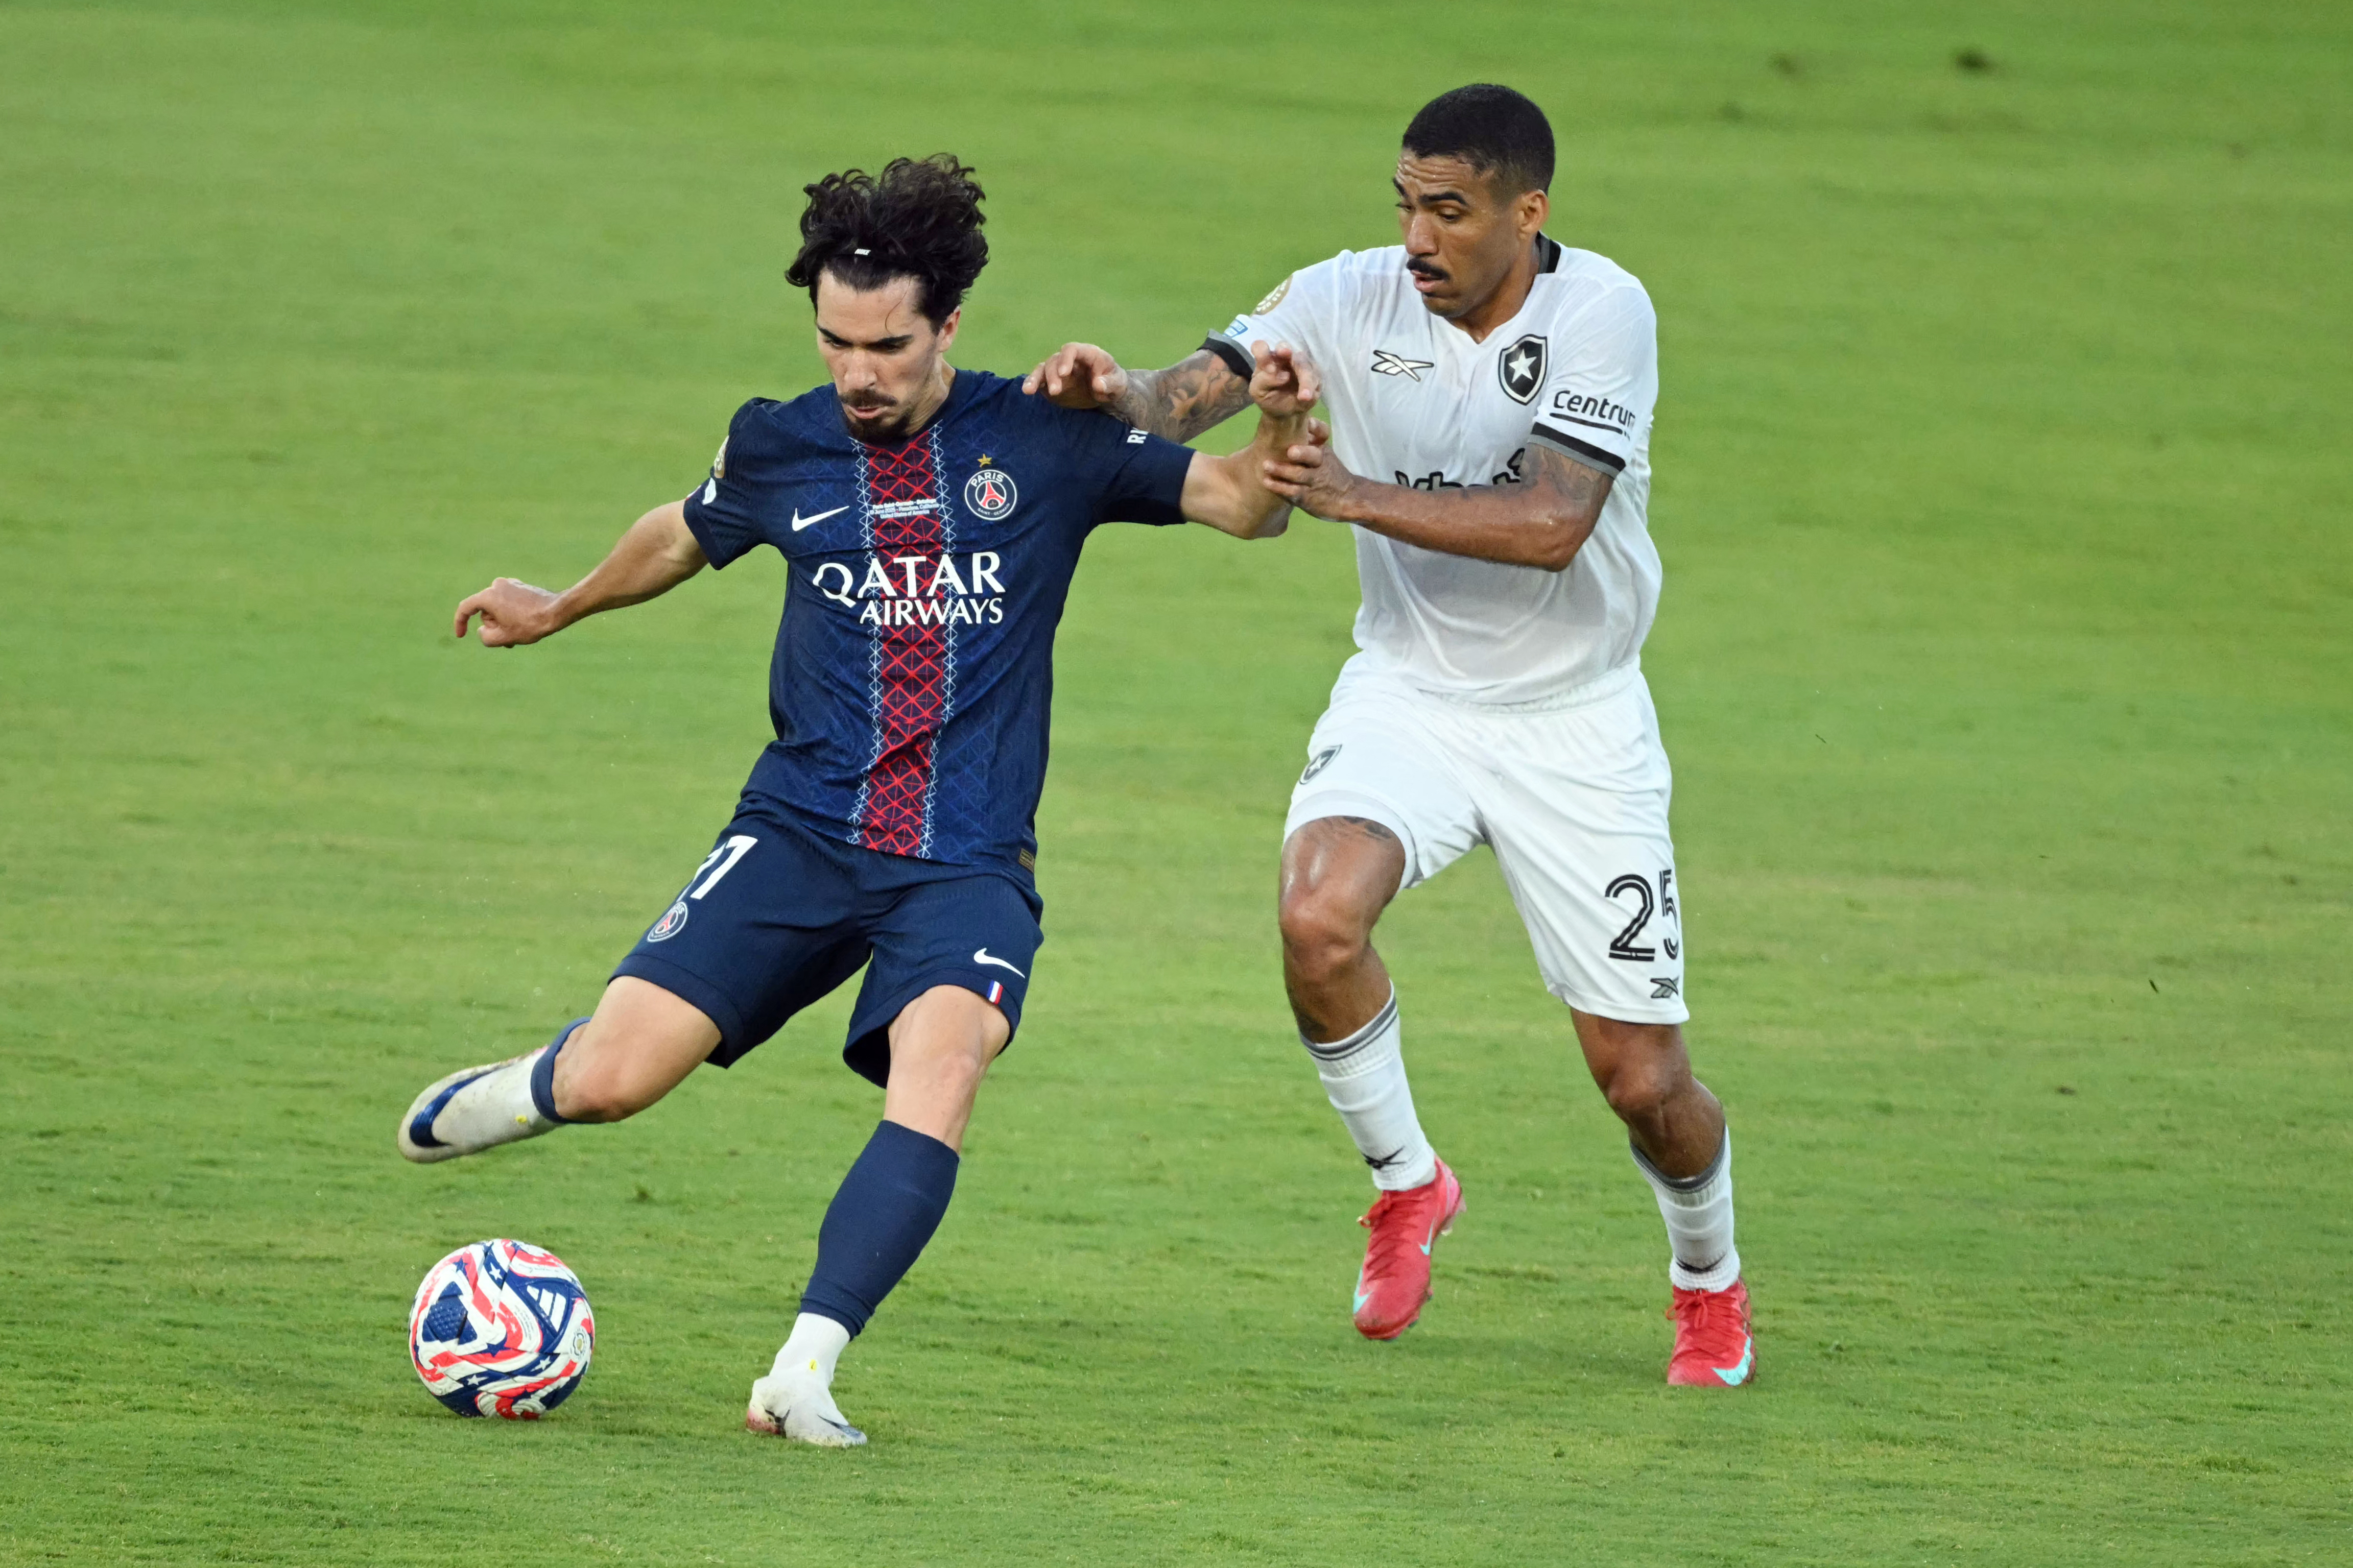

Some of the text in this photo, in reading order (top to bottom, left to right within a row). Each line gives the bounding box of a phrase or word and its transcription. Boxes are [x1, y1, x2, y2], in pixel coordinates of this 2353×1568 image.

[970, 472, 1004, 487] PARIS
[813, 551, 1006, 608] QATAR
[859, 597, 1003, 625] AIRWAYS
[1604, 869, 1679, 962] 25
